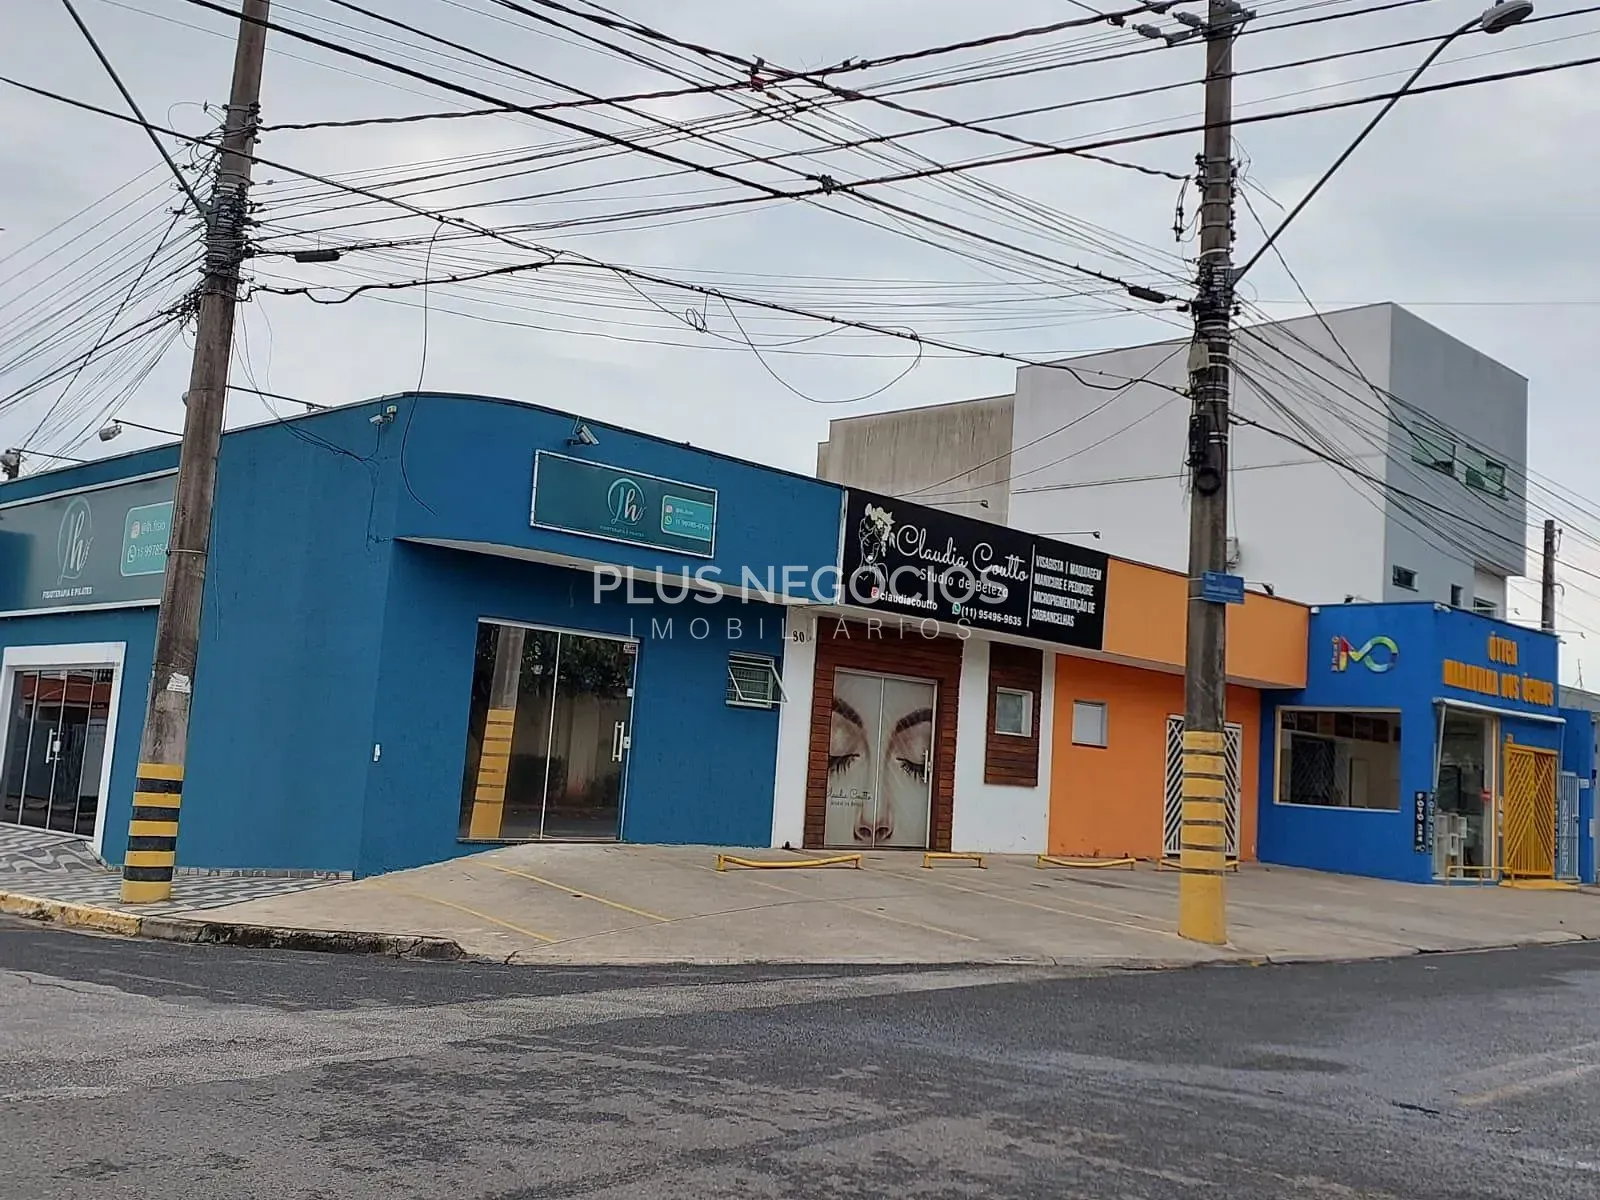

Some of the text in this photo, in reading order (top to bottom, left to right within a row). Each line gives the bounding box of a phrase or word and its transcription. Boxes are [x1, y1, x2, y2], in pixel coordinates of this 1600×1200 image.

[896, 524, 1029, 582] Claudia Coutto
[1036, 555, 1064, 573] VISAGISTA
[919, 568, 954, 586] Studio
[958, 576, 971, 590] de
[1034, 572, 1094, 597] MANICURE E PEDICURE
[1033, 591, 1096, 614] MICROPIGMENTAÇÃO DE
[961, 606, 1022, 626] (11) 95496-9635
[1031, 608, 1075, 627] SOBRANCELHAS
